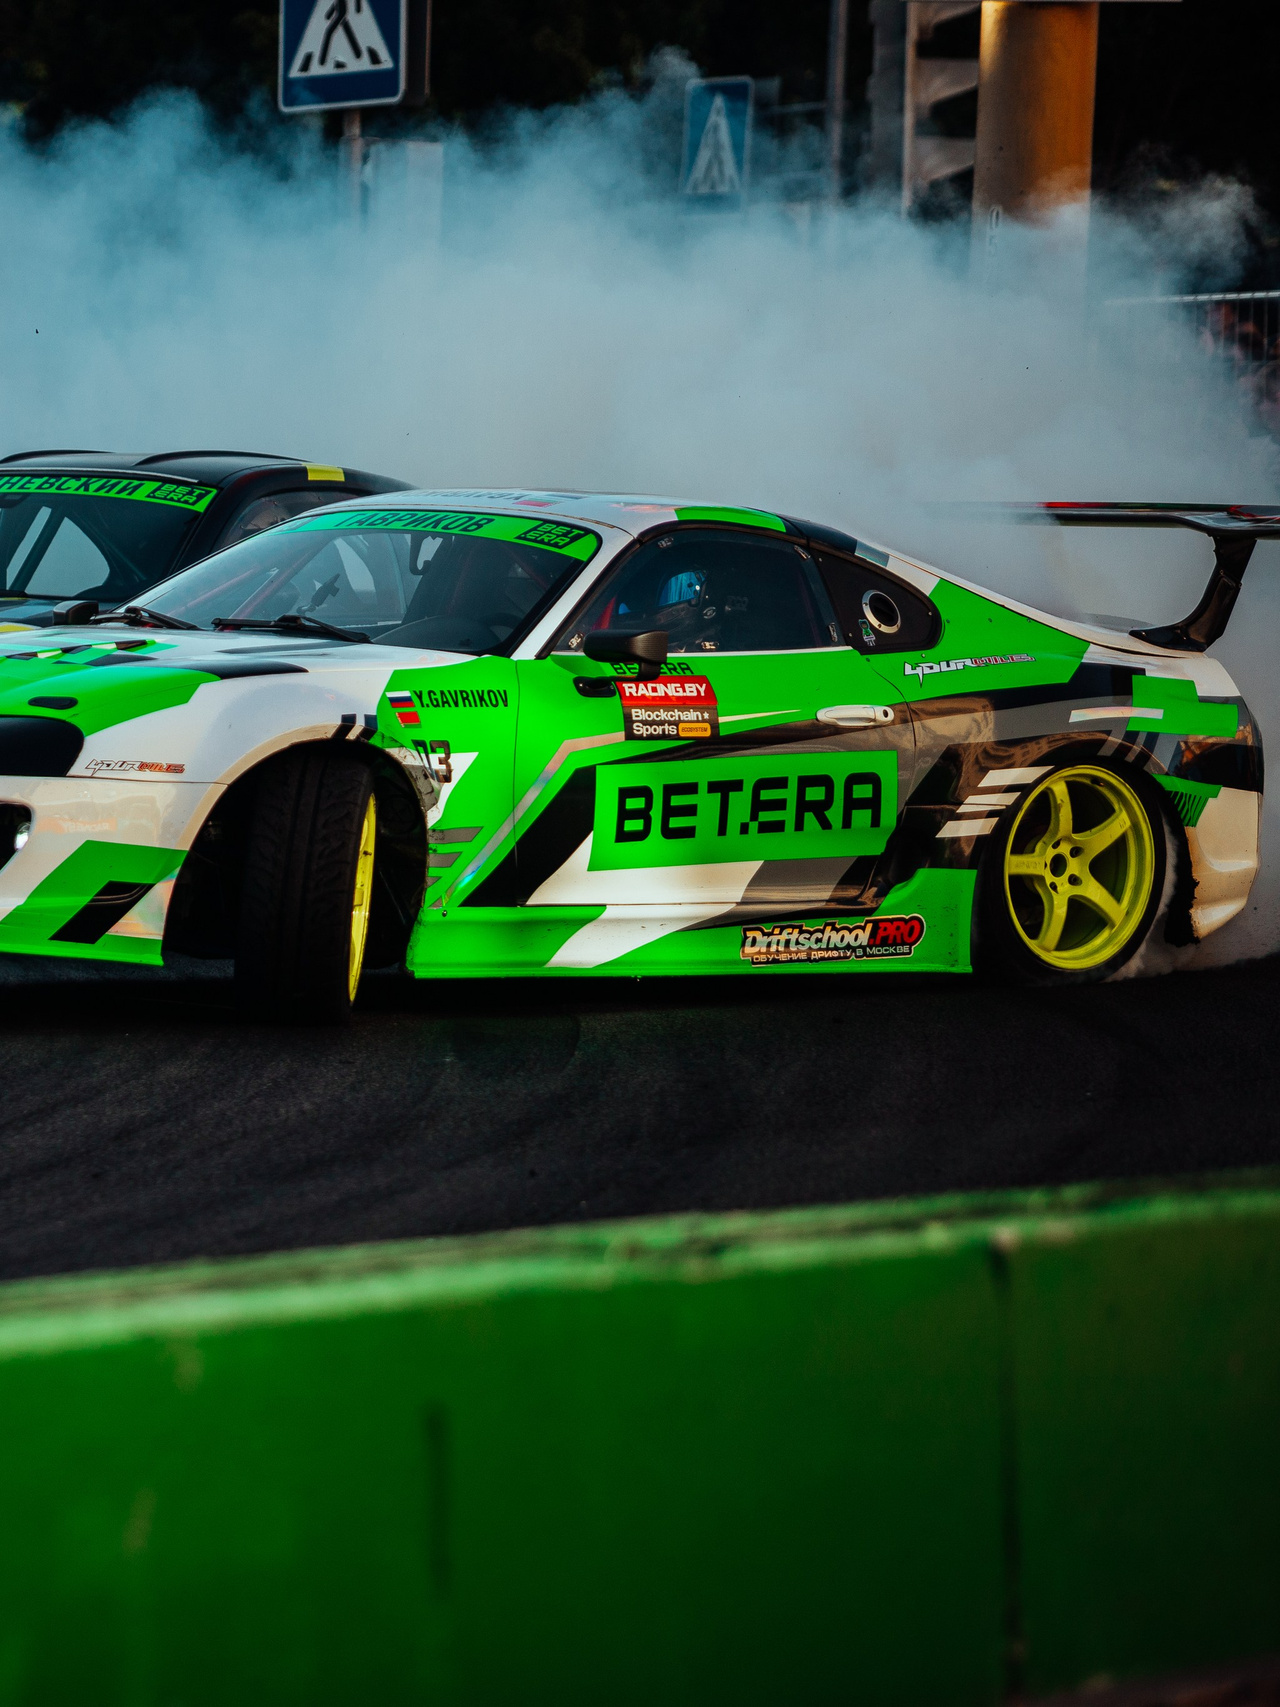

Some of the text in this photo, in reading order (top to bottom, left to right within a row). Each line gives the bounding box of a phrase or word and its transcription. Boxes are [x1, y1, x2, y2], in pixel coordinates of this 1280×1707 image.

[161, 484, 206, 496] BET
[334, 513, 495, 533] ГАВРИКОВ
[537, 523, 584, 537] BET
[521, 530, 570, 546] .ERA
[622, 683, 706, 697] RACING.BY
[413, 689, 508, 708] Y.GAVRIKOV
[631, 708, 702, 721] Blockchain
[633, 722, 677, 738] Sports
[614, 771, 882, 843] BET.ERA
[744, 919, 920, 954] Driftschool.PRO
[753, 944, 910, 963] ОБУЧЕНИЕ ДРИФТУ В МОСКВЕ
